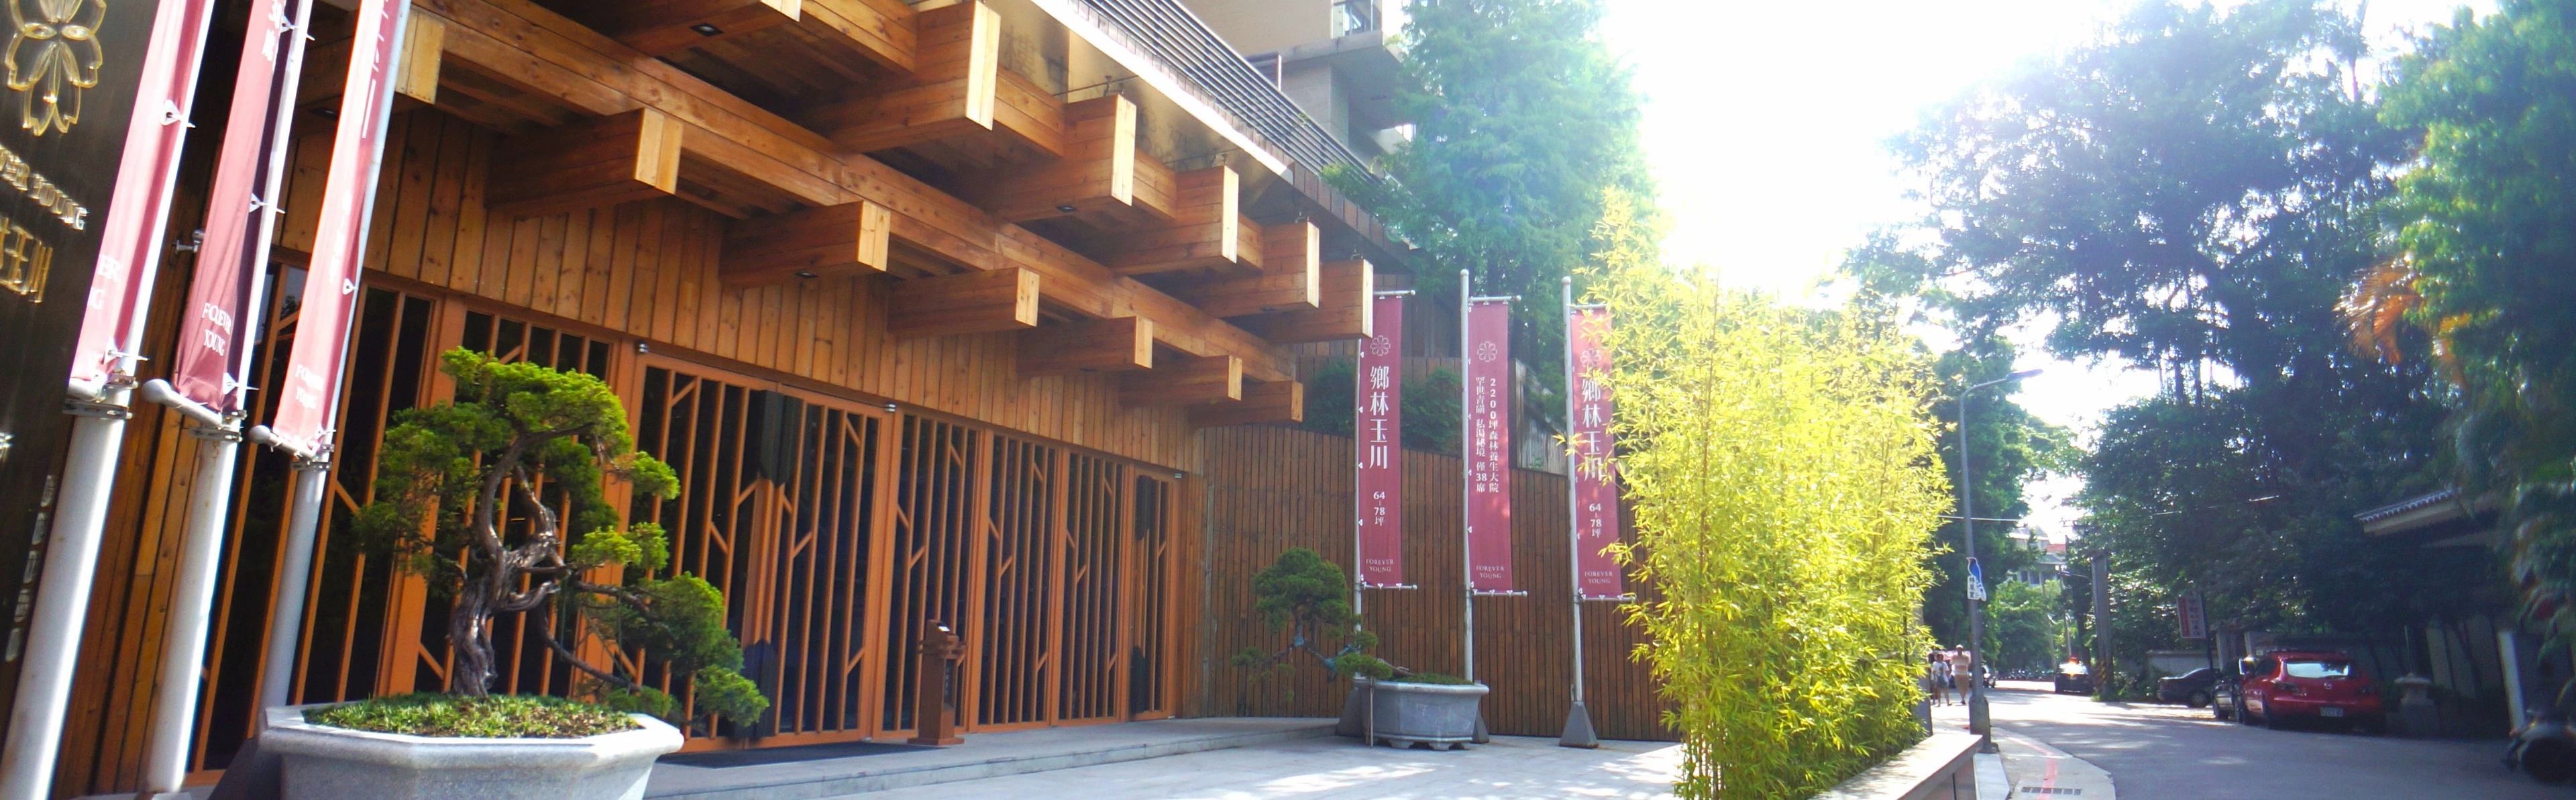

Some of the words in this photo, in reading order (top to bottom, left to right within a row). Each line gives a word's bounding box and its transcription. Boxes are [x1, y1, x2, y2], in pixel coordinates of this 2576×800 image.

[29, 172, 89, 230] YOUNG
[202, 302, 231, 336] FOEER
[1369, 366, 1389, 470] 鄉林玉川
